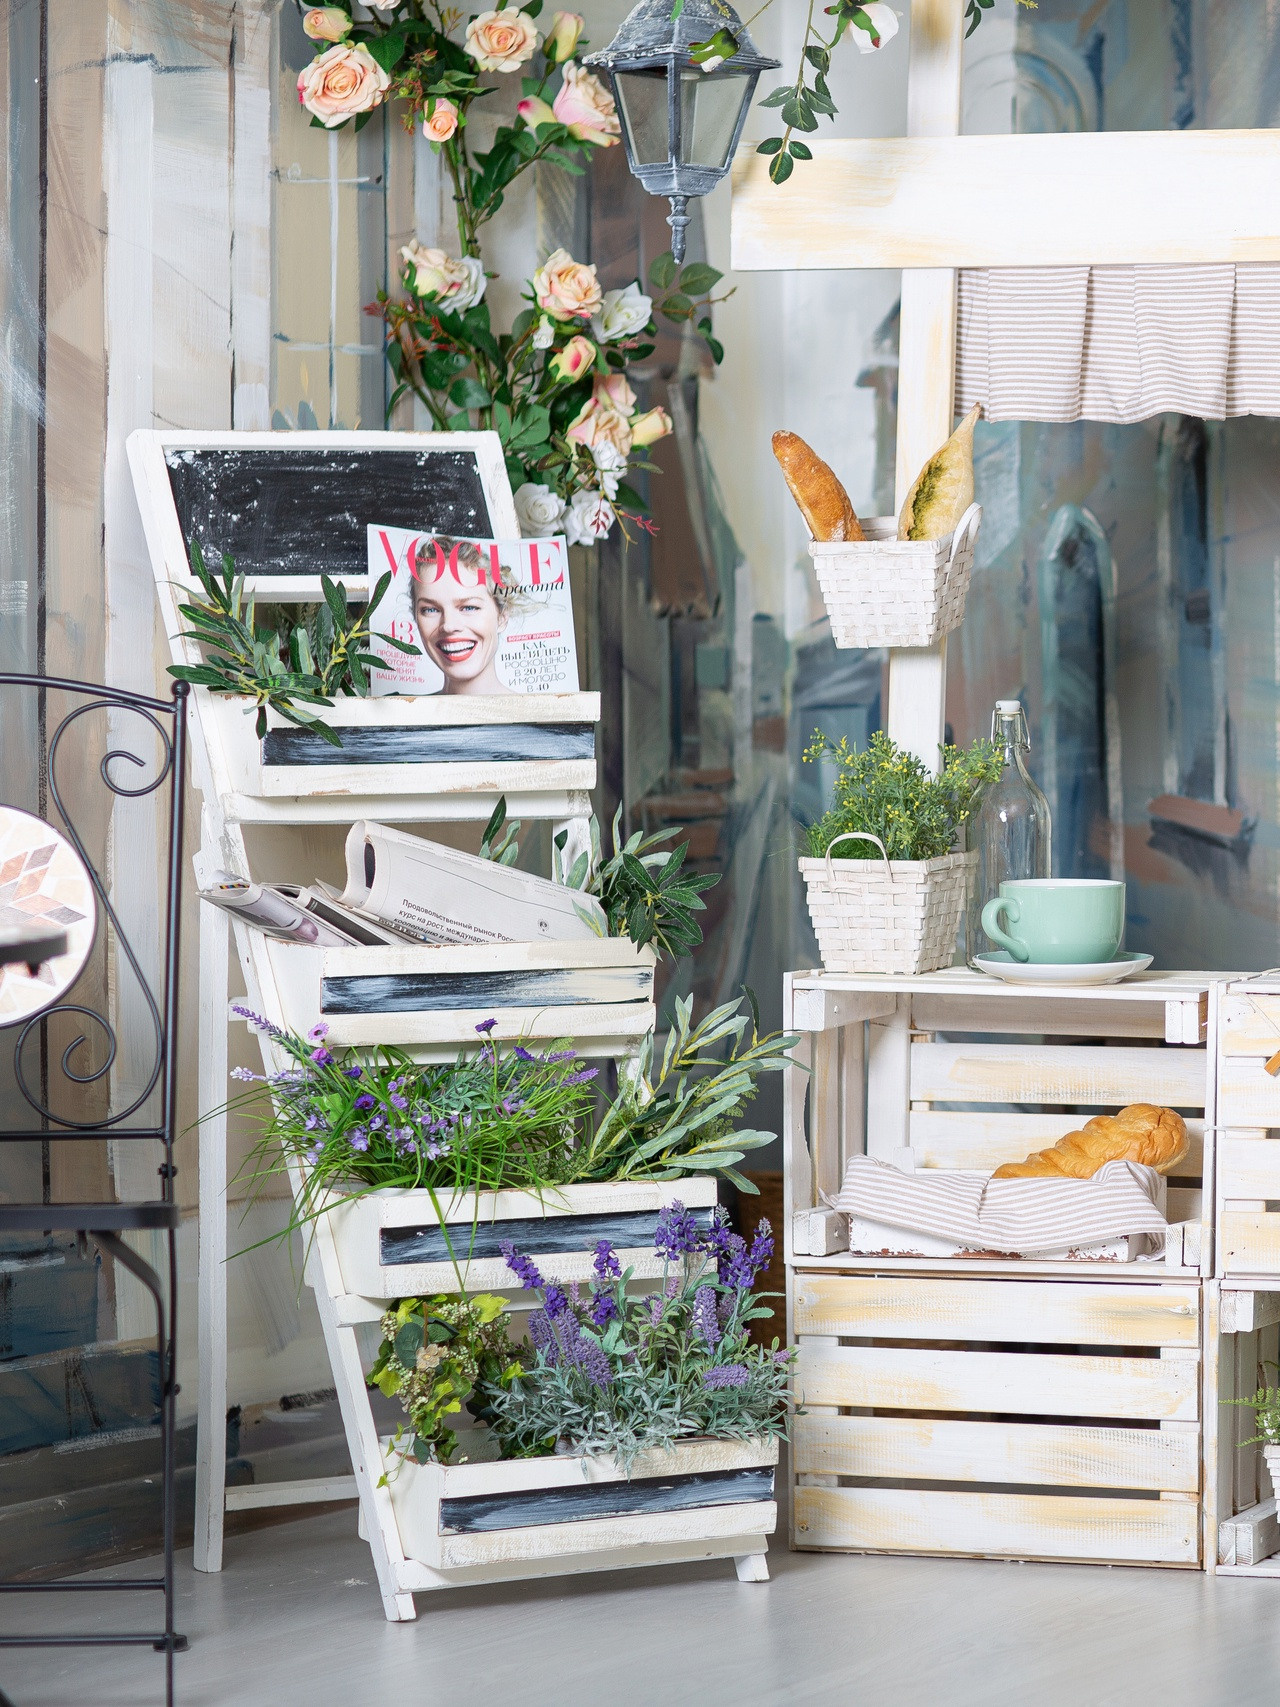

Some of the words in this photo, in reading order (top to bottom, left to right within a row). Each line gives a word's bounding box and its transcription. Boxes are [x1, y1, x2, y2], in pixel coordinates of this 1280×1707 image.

[378, 530, 564, 588] VOGUE
[493, 581, 565, 597] Красота
[383, 619, 414, 643] 43
[522, 641, 547, 650] КАК
[501, 646, 571, 661] ВЫГЛЯДЕТЬ
[504, 655, 568, 669] РОСКОШНО
[376, 672, 397, 681] ВАШУ
[399, 675, 425, 683] ЖИЗНЬ
[514, 669, 521, 677] В
[523, 667, 537, 676] 20
[539, 664, 557, 674] ЛЕТ
[508, 678, 517, 687] И
[518, 672, 567, 686] МОЛОДО
[526, 684, 534, 693] В
[398, 909, 417, 921] курс
[416, 916, 427, 925] на
[426, 919, 445, 932] рост,
[446, 927, 490, 943] междунаро
[402, 898, 473, 931] Продовольственный
[473, 926, 496, 939] рынок
[393, 918, 438, 937] кооперацию
